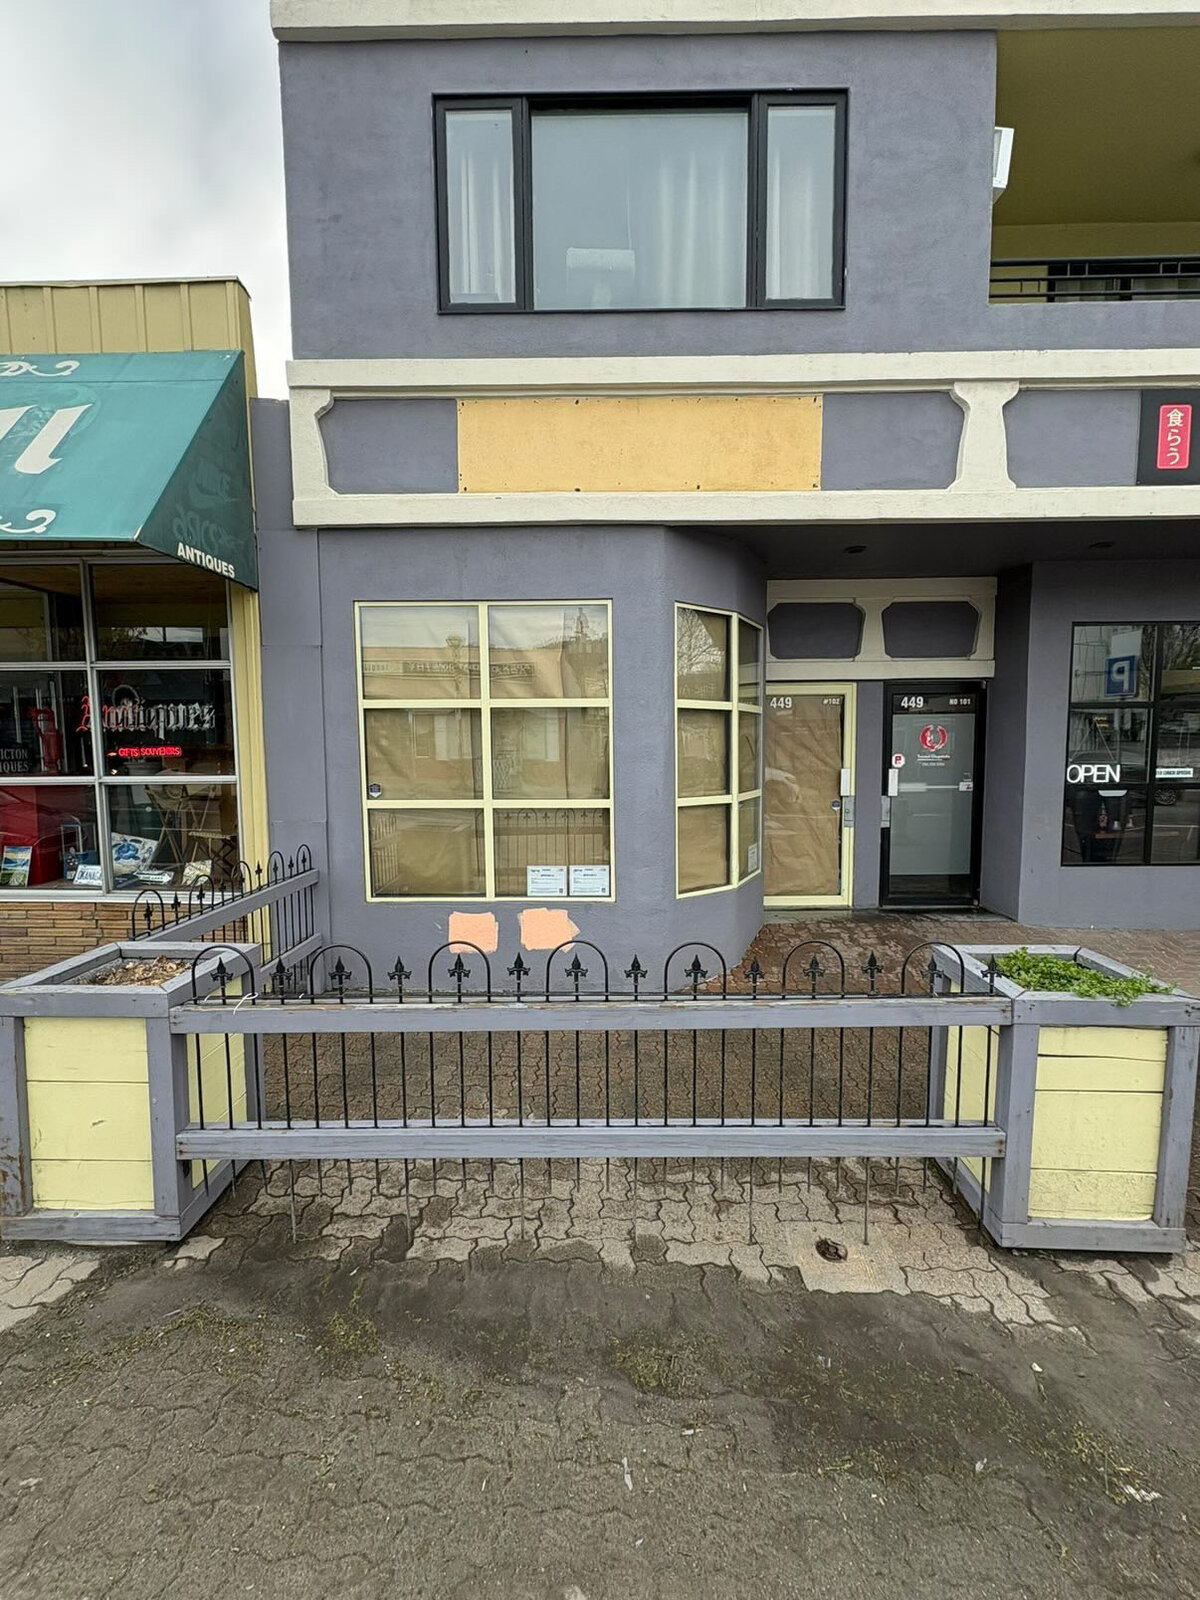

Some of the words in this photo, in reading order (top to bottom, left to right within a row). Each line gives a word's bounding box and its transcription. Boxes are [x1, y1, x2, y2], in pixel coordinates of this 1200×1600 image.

[1166, 408, 1185, 465] 食らう
[177, 541, 236, 579] ANTIQUES
[769, 696, 793, 709] 449
[900, 696, 924, 709] 449
[1066, 764, 1121, 783] OPEN
